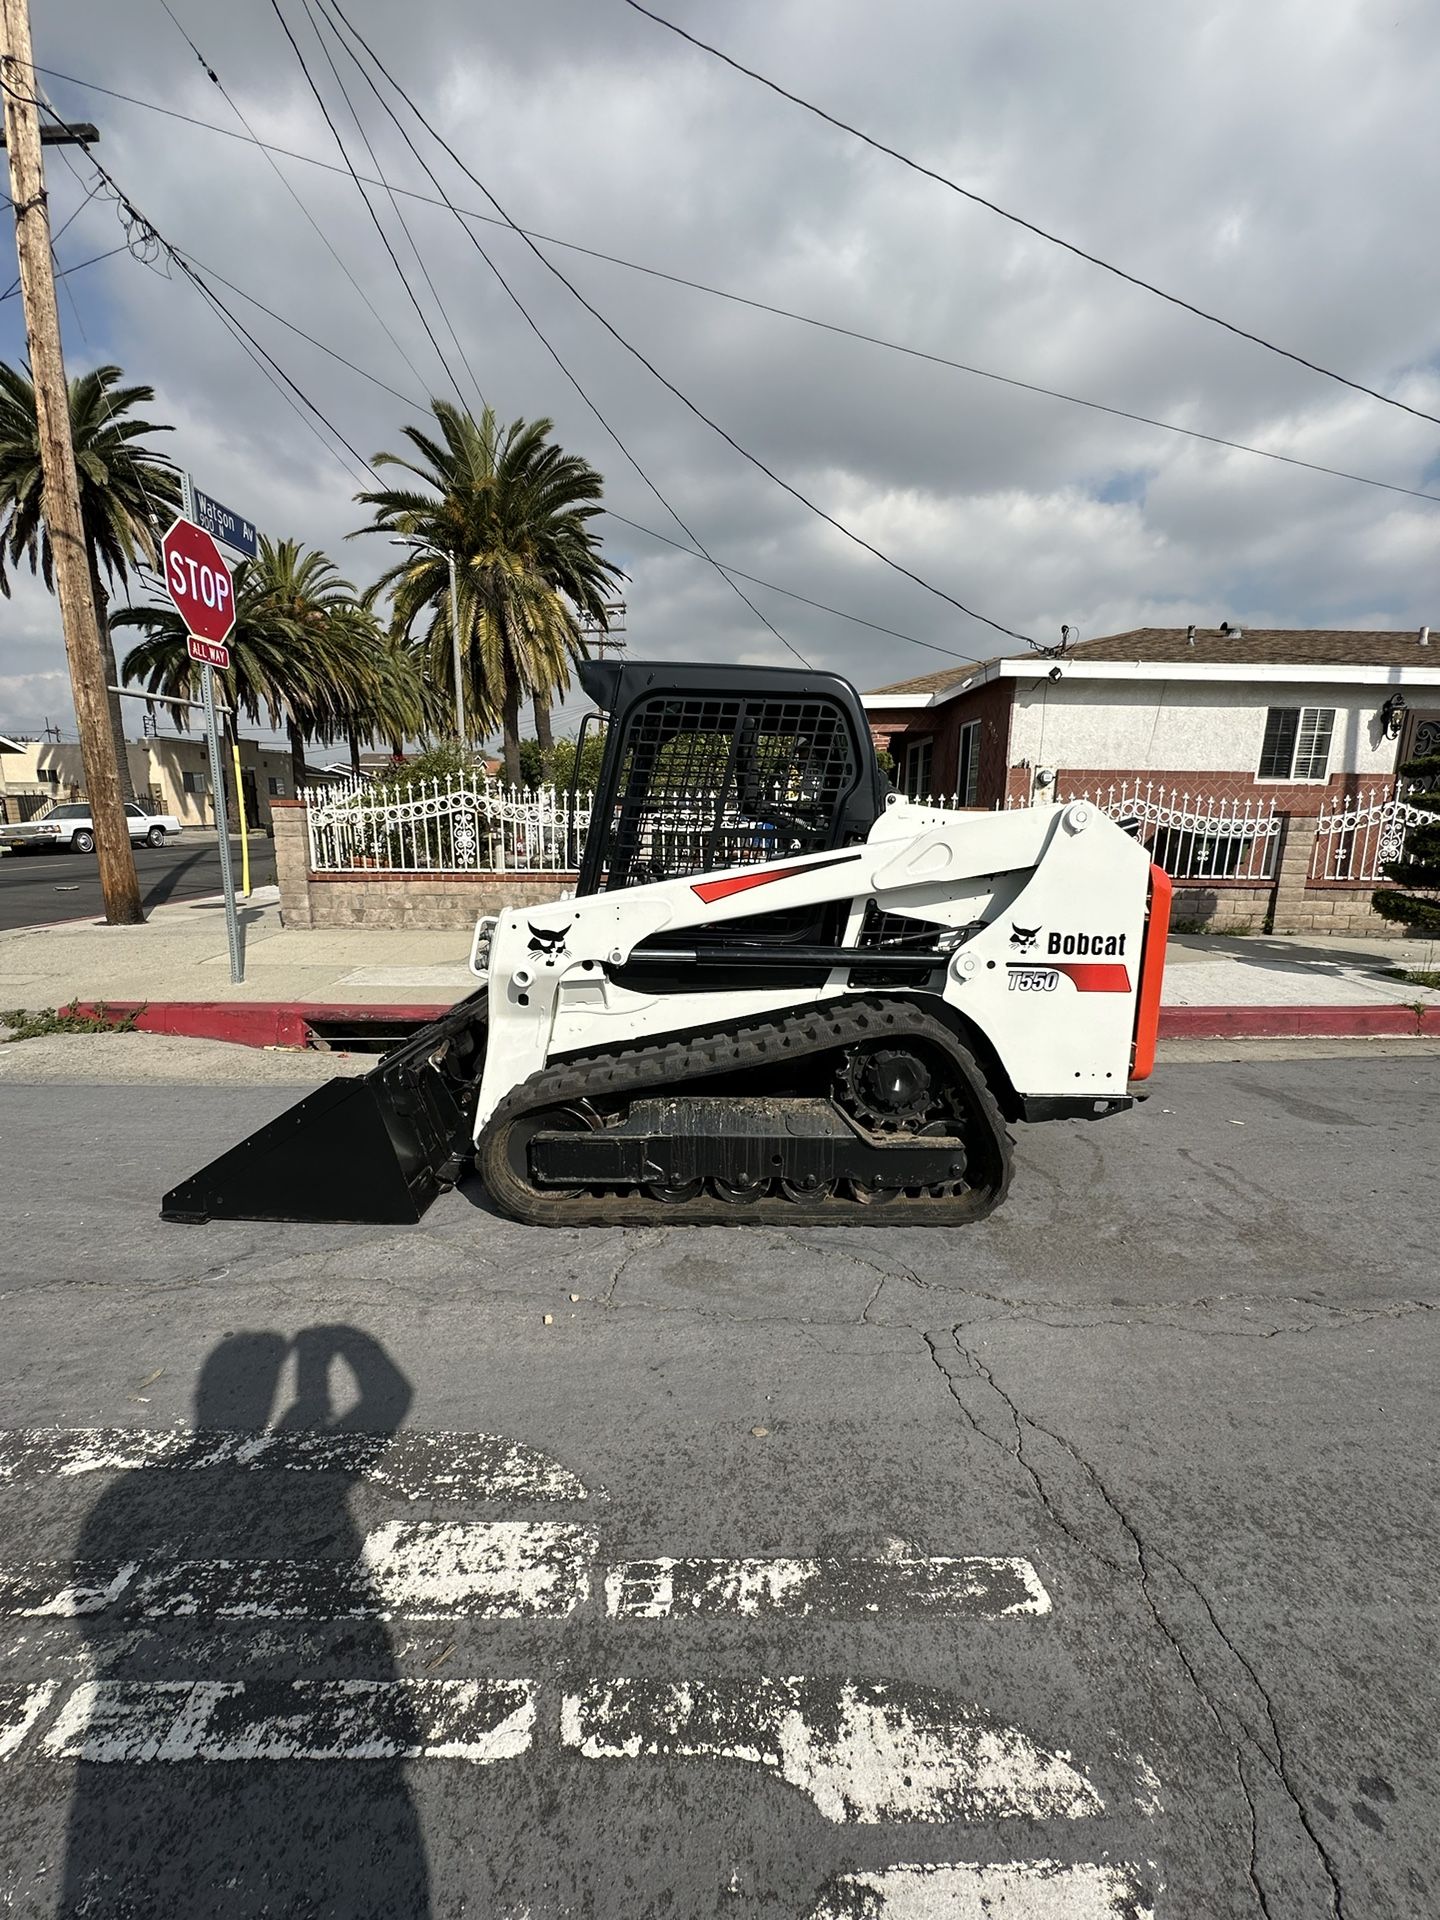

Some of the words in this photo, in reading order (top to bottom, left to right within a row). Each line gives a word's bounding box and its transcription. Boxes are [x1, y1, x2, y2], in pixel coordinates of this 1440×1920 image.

[197, 493, 235, 532] Watson
[242, 522, 254, 542] Av
[199, 513, 215, 533] 900
[218, 525, 225, 538] N
[170, 551, 229, 612] STOP
[192, 643, 207, 658] ALL
[208, 649, 226, 664] WAY
[1048, 932, 1126, 956] Bobcat
[1008, 971, 1059, 992] T550
